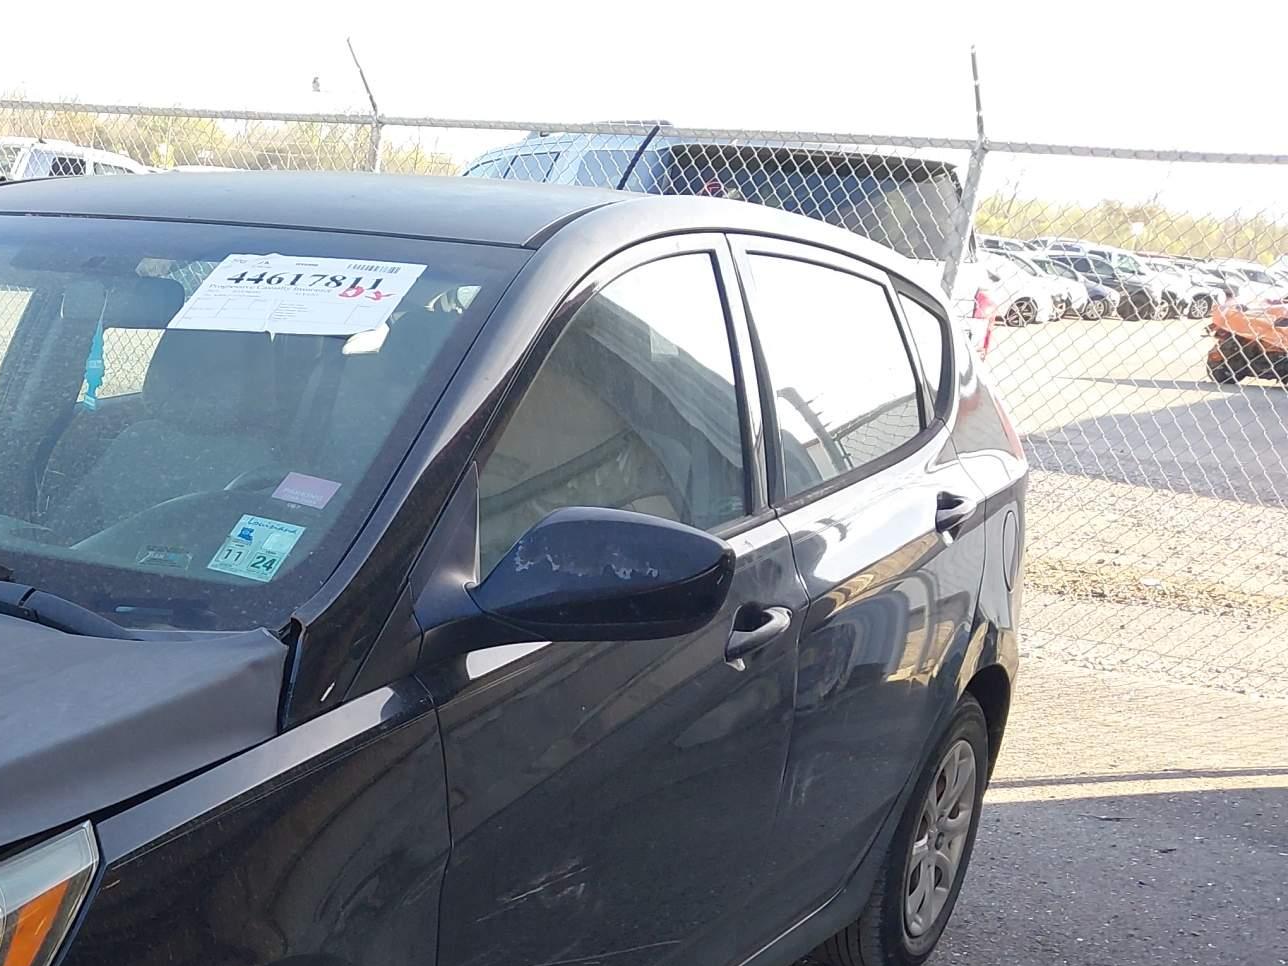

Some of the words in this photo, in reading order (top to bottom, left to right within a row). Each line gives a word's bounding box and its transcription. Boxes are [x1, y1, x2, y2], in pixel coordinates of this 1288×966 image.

[226, 270, 384, 290] 44617811
[248, 517, 297, 534] Louisiana
[223, 548, 243, 562] 11
[250, 555, 277, 572] 24
